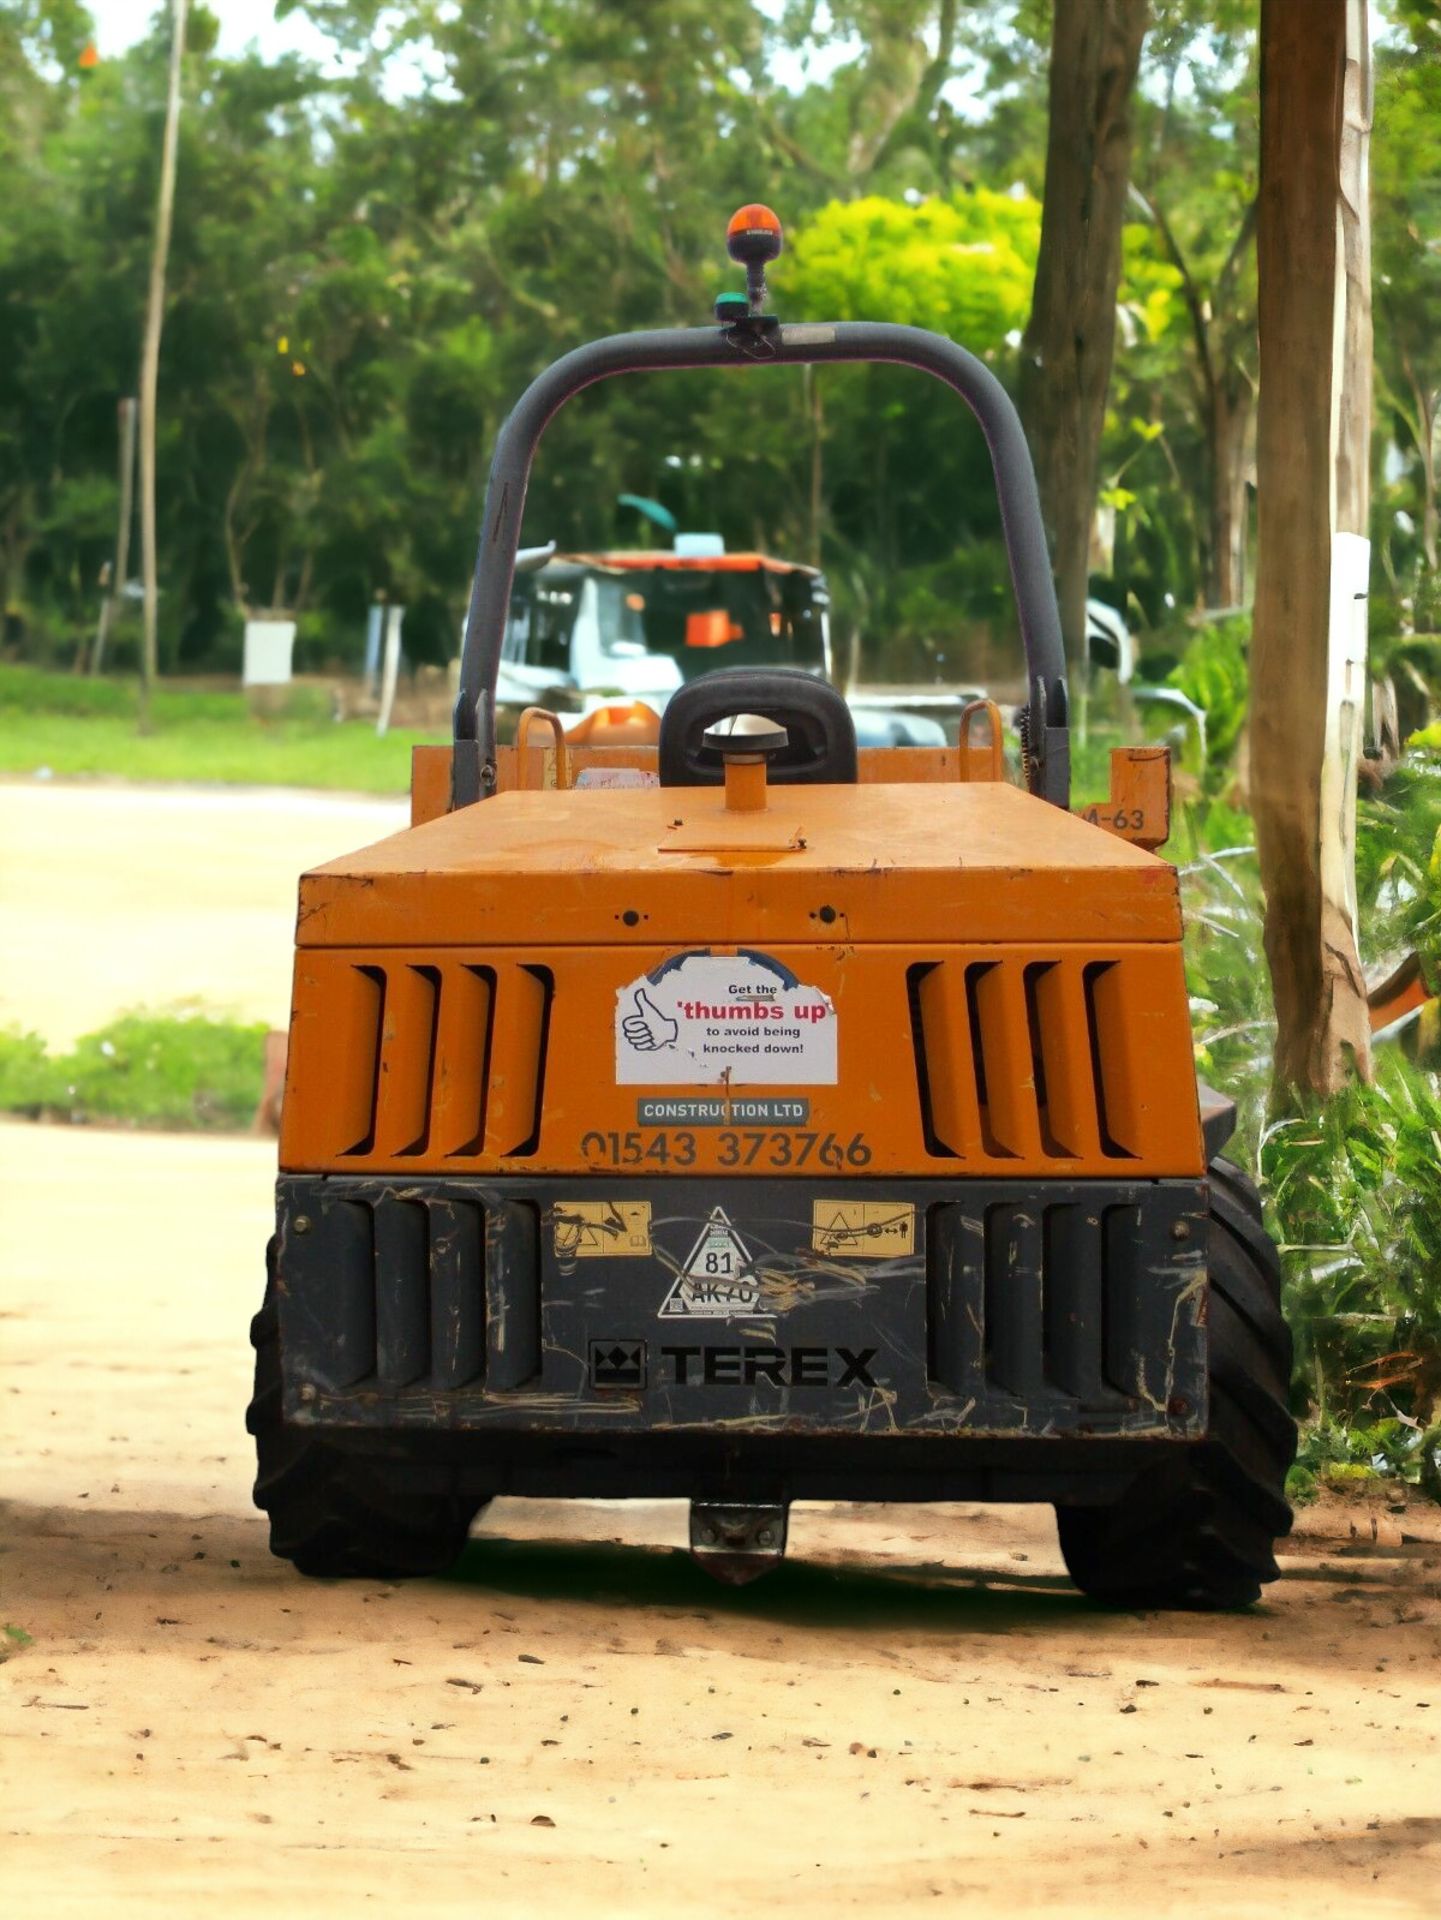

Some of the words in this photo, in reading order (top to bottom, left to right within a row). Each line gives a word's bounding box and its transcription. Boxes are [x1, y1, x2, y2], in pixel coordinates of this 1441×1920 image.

[728, 984, 752, 995] Get
[756, 984, 778, 995] the
[677, 1001, 784, 1020] 'thumbs
[706, 1027, 720, 1036] to
[724, 1027, 760, 1037] avoid
[764, 1027, 801, 1039] being
[703, 1044, 760, 1054] knocked
[764, 1044, 804, 1054] down!
[774, 1104, 803, 1117] LTD
[581, 1132, 696, 1166] 01543
[717, 1132, 872, 1168] 373766
[705, 1252, 734, 1275] 81
[661, 1346, 880, 1388] TEREX
